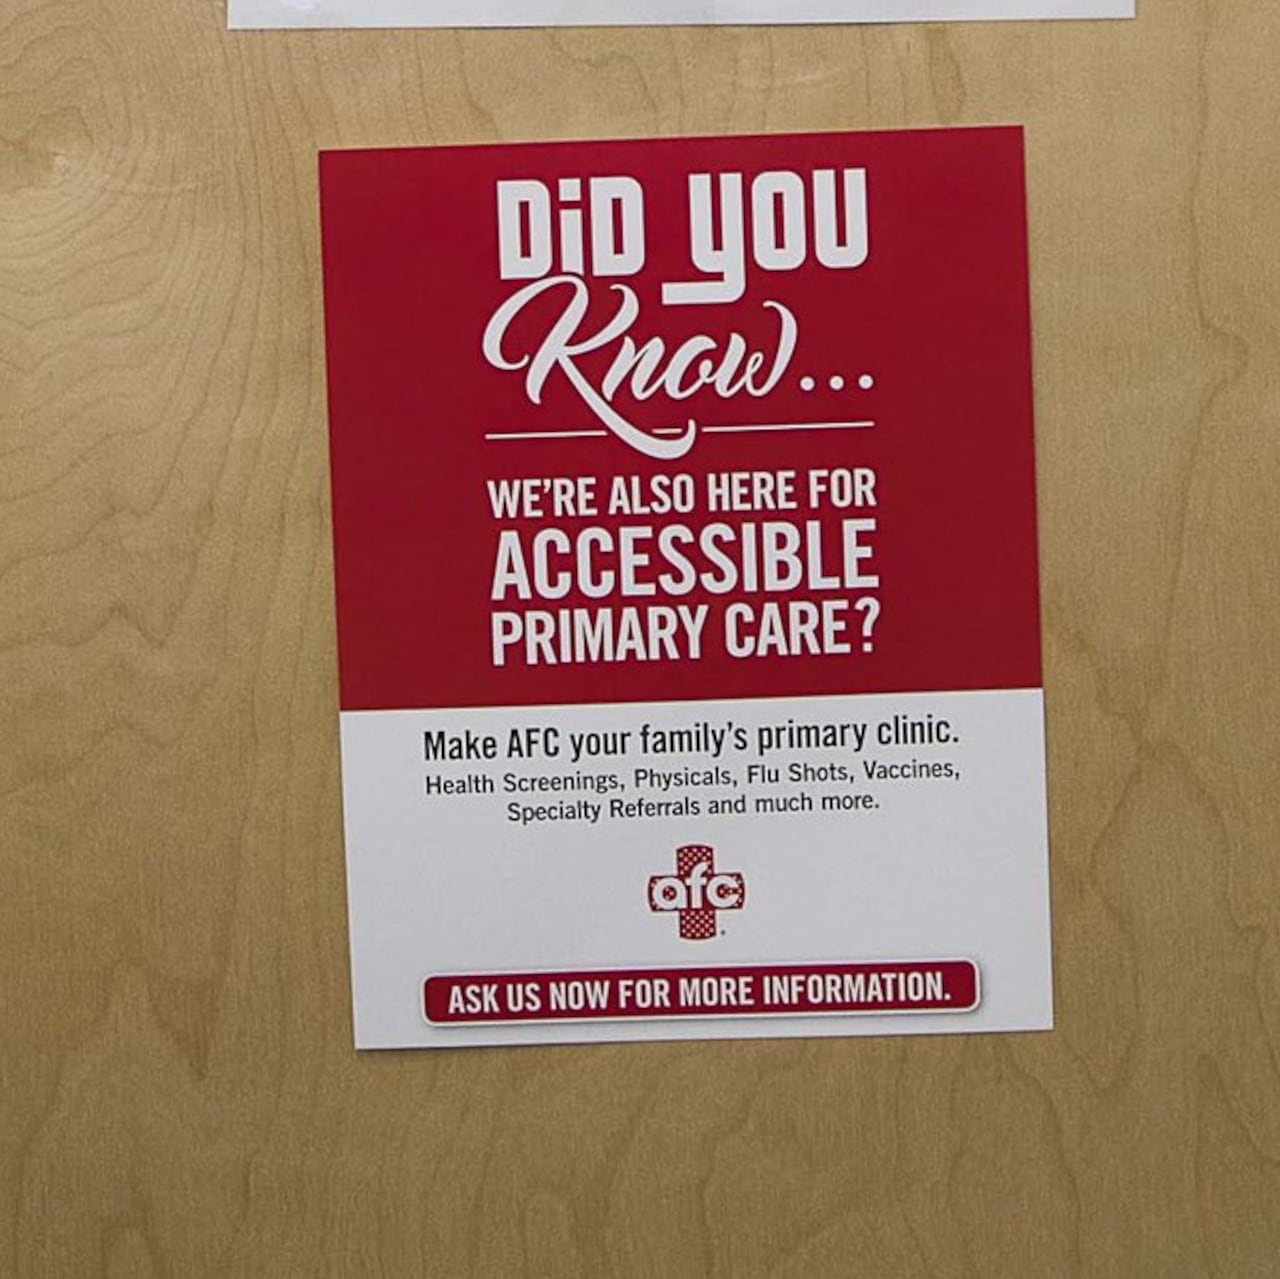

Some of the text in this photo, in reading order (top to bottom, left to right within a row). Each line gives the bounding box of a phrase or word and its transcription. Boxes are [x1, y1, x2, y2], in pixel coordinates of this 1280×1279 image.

[483, 274, 874, 459] Know...
[488, 469, 876, 518] WE'RE ALSO HERE FOR
[492, 519, 878, 600] ACCESSIBLE
[492, 597, 879, 665] PRIMARY CARE?
[425, 714, 958, 763] Make AFC your family's primary clinic.
[426, 759, 959, 794] Health Screenings, Physicals, Flu Shots, Vaccines,
[508, 792, 879, 825] Specialty Referrals and much more.
[652, 861, 741, 909] afc
[449, 972, 950, 1013] ASK US NOW FOR MORE INFORMATION.
